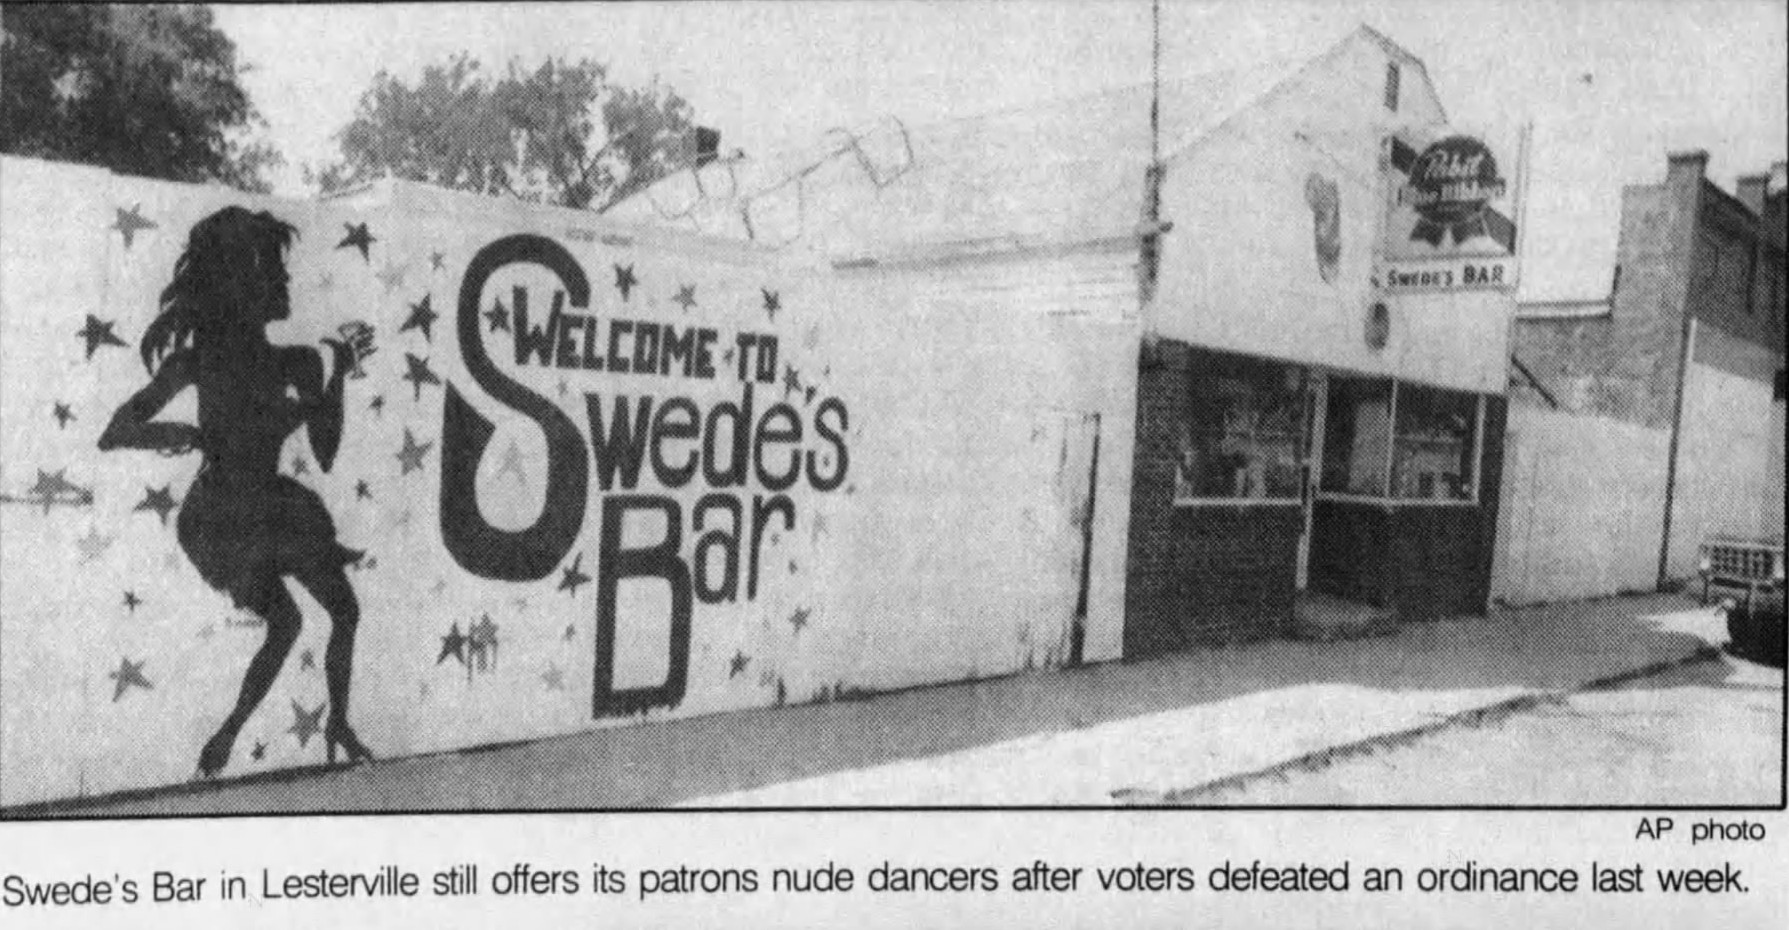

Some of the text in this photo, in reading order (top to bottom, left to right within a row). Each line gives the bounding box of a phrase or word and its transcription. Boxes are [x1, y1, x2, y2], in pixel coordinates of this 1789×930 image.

[1463, 264, 1504, 284] BAR
[512, 284, 779, 384] WELCOME TO
[592, 494, 795, 719] Bar
